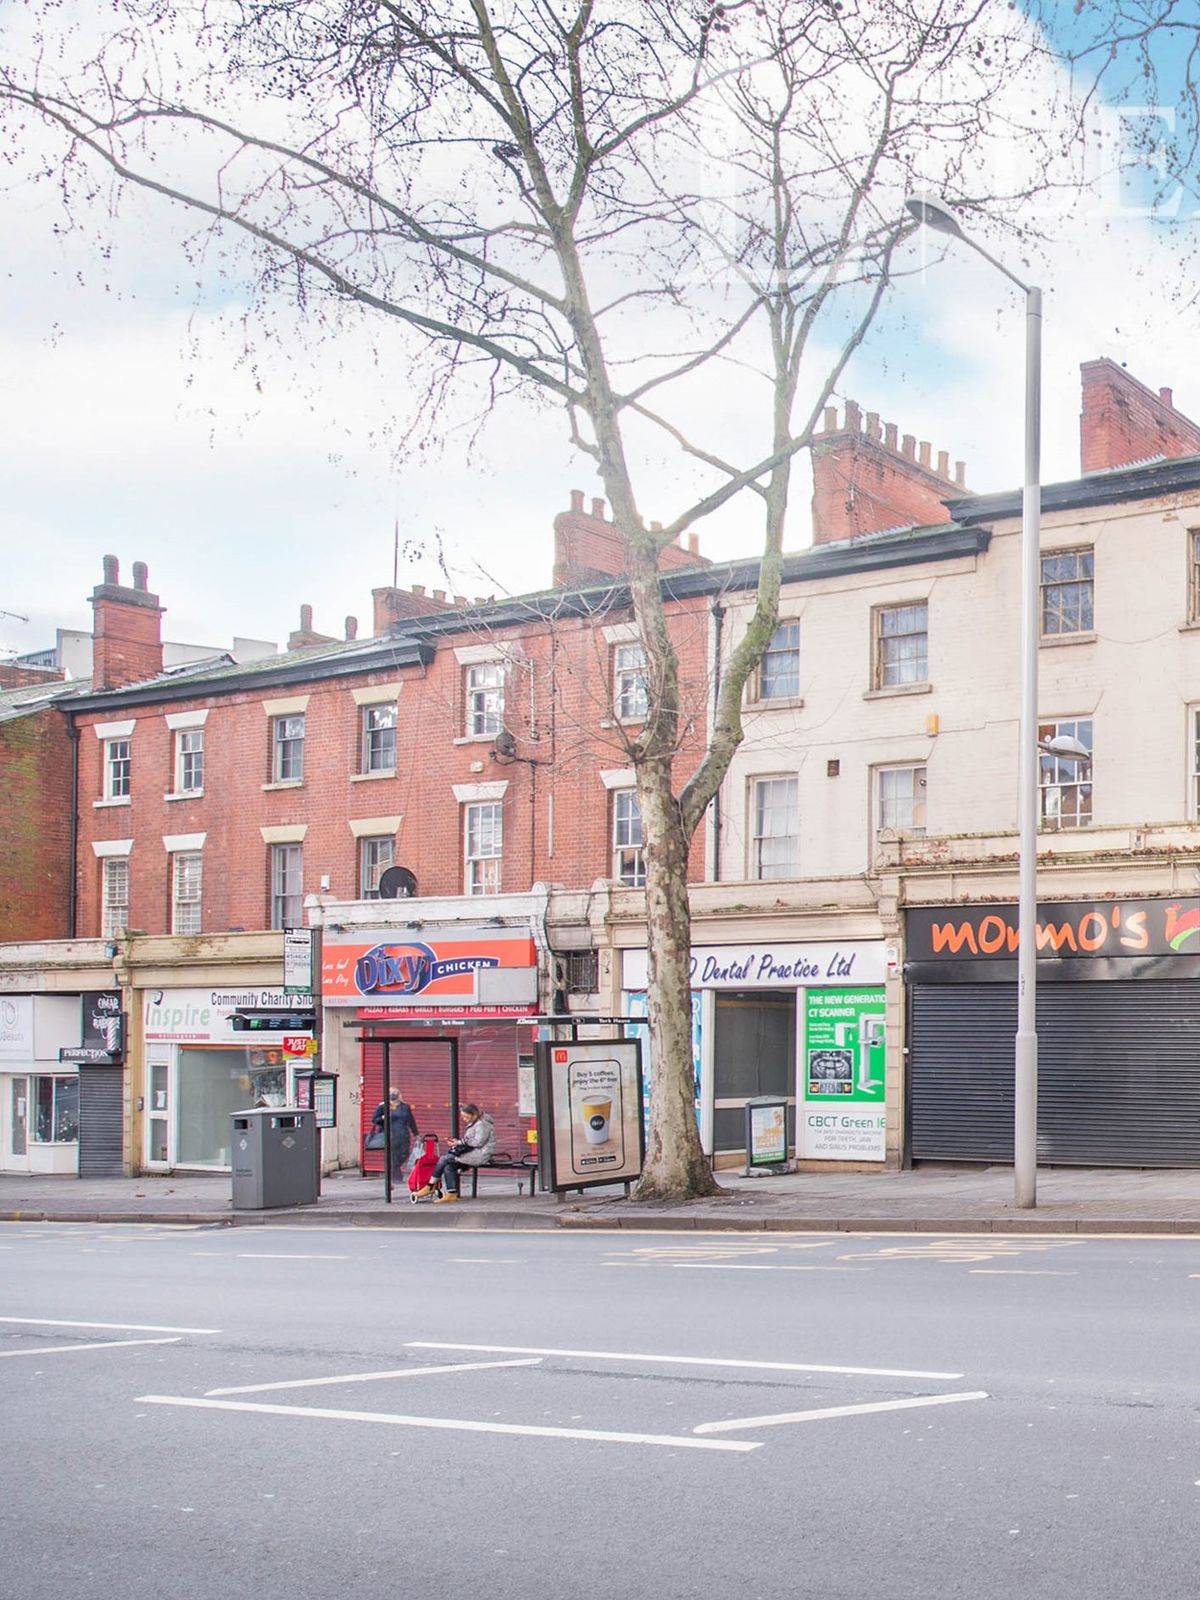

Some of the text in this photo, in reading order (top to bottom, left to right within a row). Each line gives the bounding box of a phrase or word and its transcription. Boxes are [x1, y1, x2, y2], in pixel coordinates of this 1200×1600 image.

[437, 961, 491, 975] CHICKEN
[757, 952, 819, 980] Practice
[826, 952, 856, 978] Ltd
[356, 953, 430, 992] Dixy
[211, 991, 258, 1008] Community
[261, 990, 294, 1008] Charity
[808, 996, 823, 1005] THE
[825, 995, 842, 1004] NEW
[145, 1002, 211, 1032] Inspire
[808, 1008, 856, 1017] CT SCANNER
[287, 1039, 307, 1047] JUST
[291, 1044, 307, 1052] EAT
[63, 1048, 109, 1058] PERFECTION
[807, 1116, 838, 1127] CBCT
[841, 1116, 873, 1128] Green
